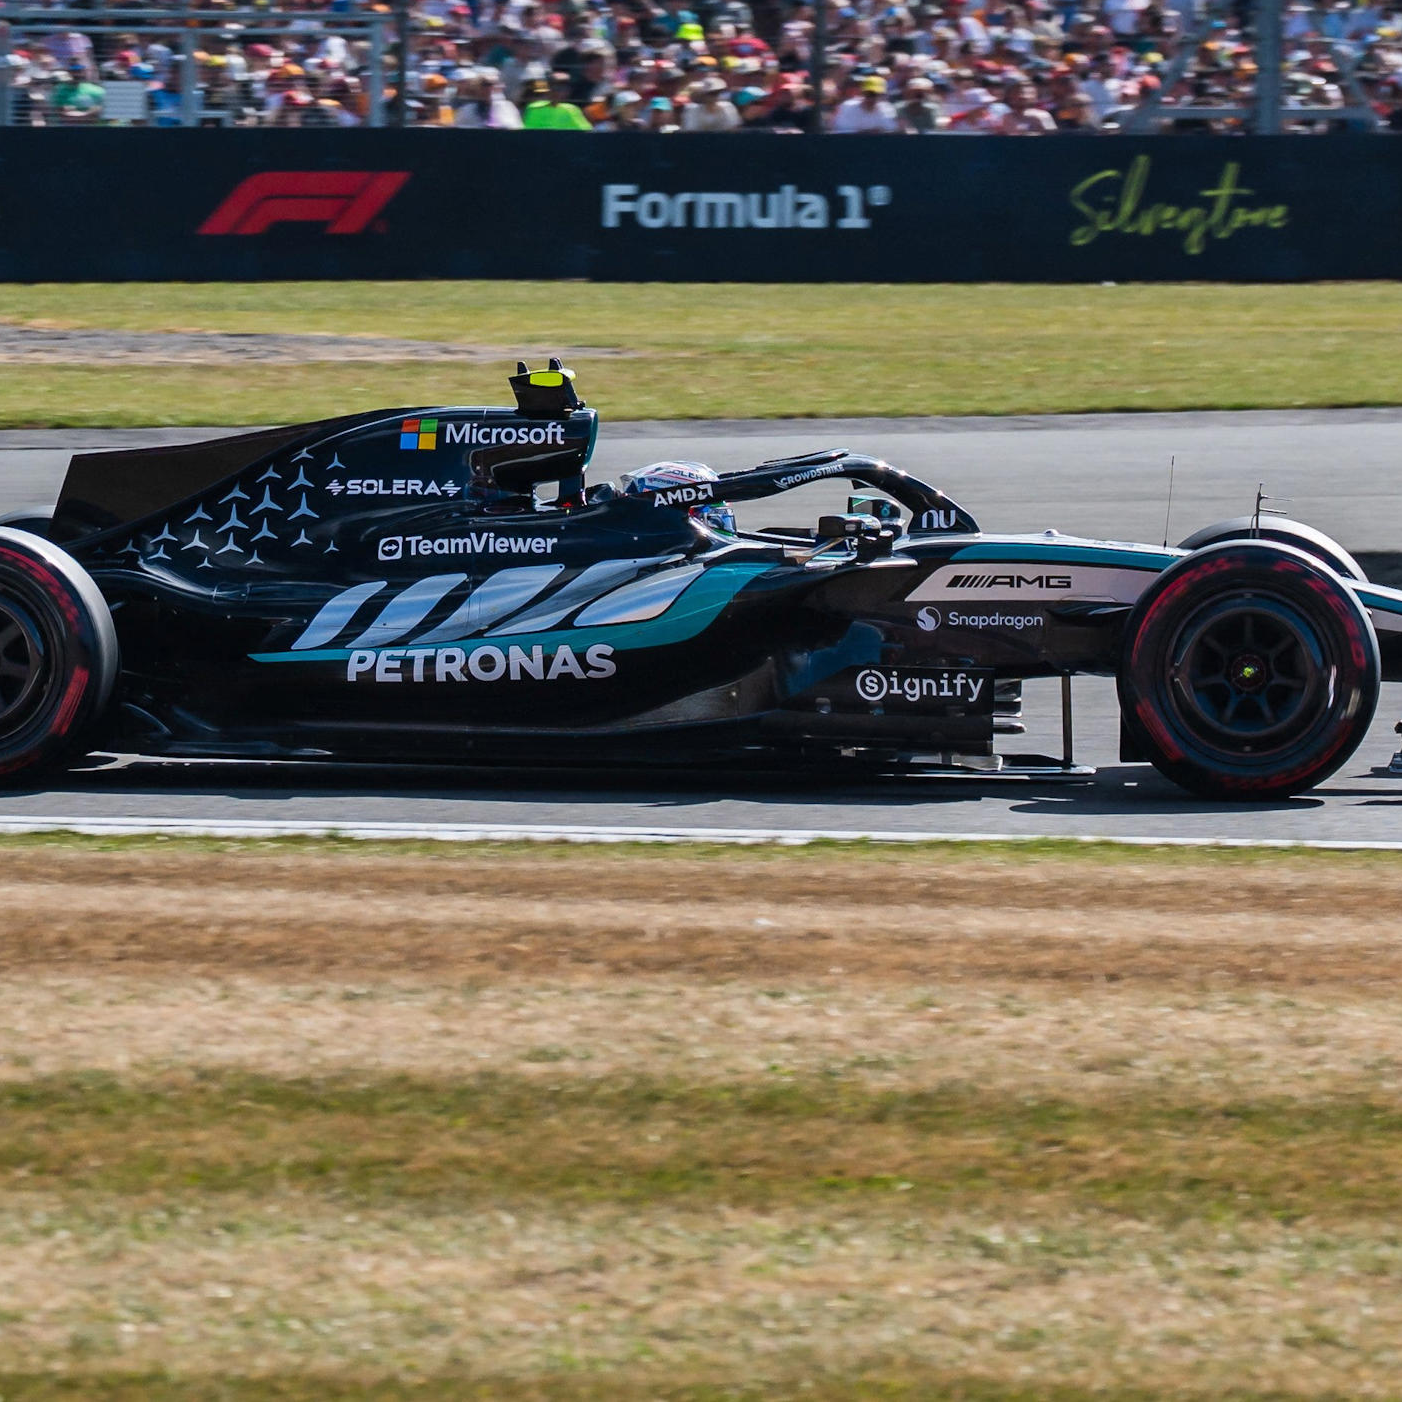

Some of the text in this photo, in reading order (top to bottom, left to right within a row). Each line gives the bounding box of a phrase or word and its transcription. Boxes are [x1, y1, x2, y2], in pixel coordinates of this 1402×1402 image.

[602, 184, 828, 229] Formula
[445, 420, 565, 446] Microsoft
[780, 463, 845, 485] CROWDSTRIKE
[346, 479, 441, 496] SOLERA
[653, 486, 697, 508] AMD
[405, 532, 558, 556] TeamViewer
[985, 575, 1072, 589] AMG
[948, 611, 1044, 630] Snapdragon
[346, 642, 617, 682] PETRONAS
